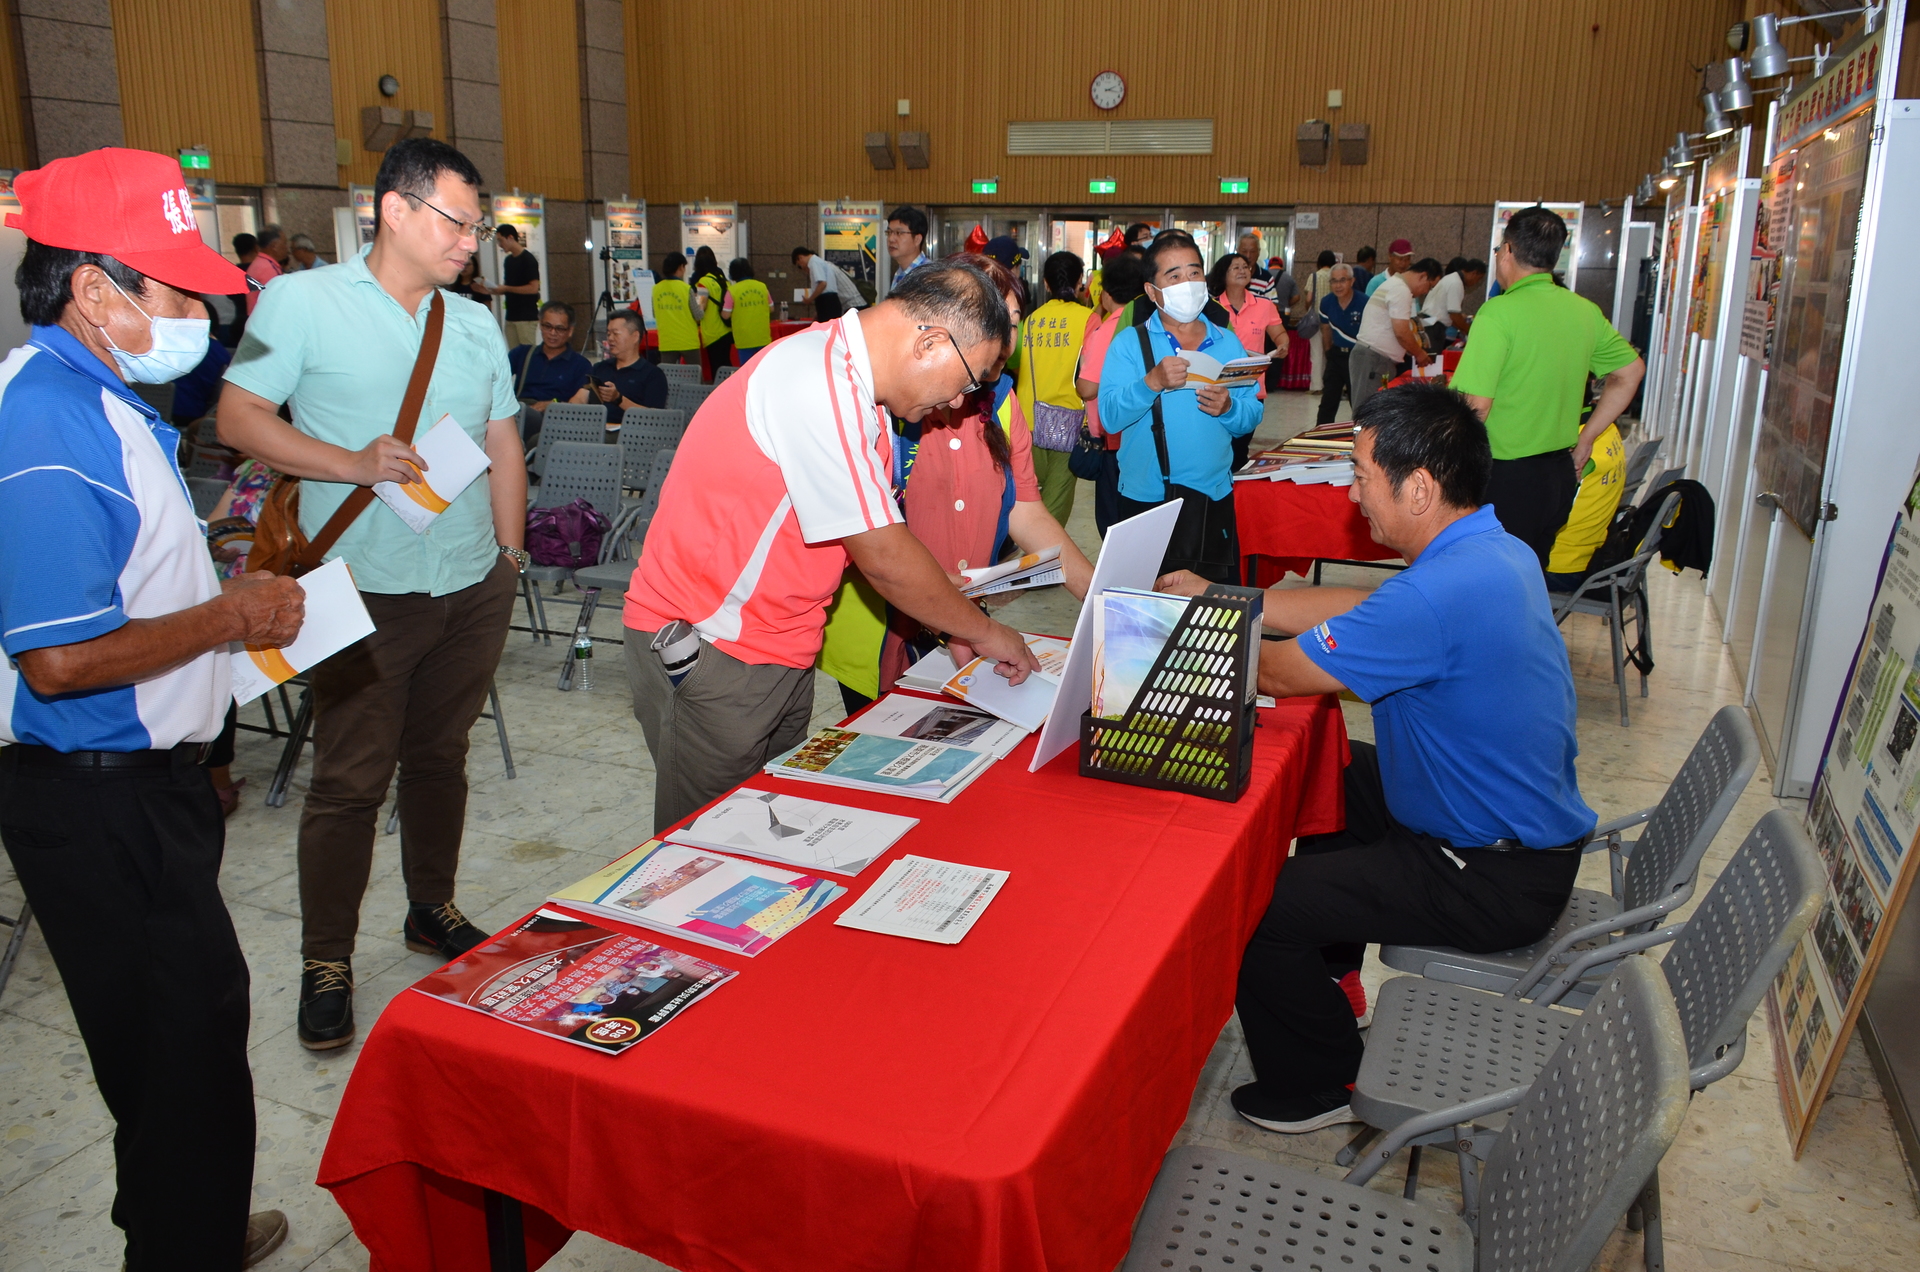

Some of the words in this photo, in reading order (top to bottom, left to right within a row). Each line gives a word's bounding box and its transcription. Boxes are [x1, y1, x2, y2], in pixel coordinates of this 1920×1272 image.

[1029, 317, 1068, 329] 中華社區
[479, 956, 565, 1008] 大樹區久堂社區
[508, 982, 547, 1006] 高雄市
[592, 1020, 622, 1038] 年度
[611, 1024, 634, 1040] 108
